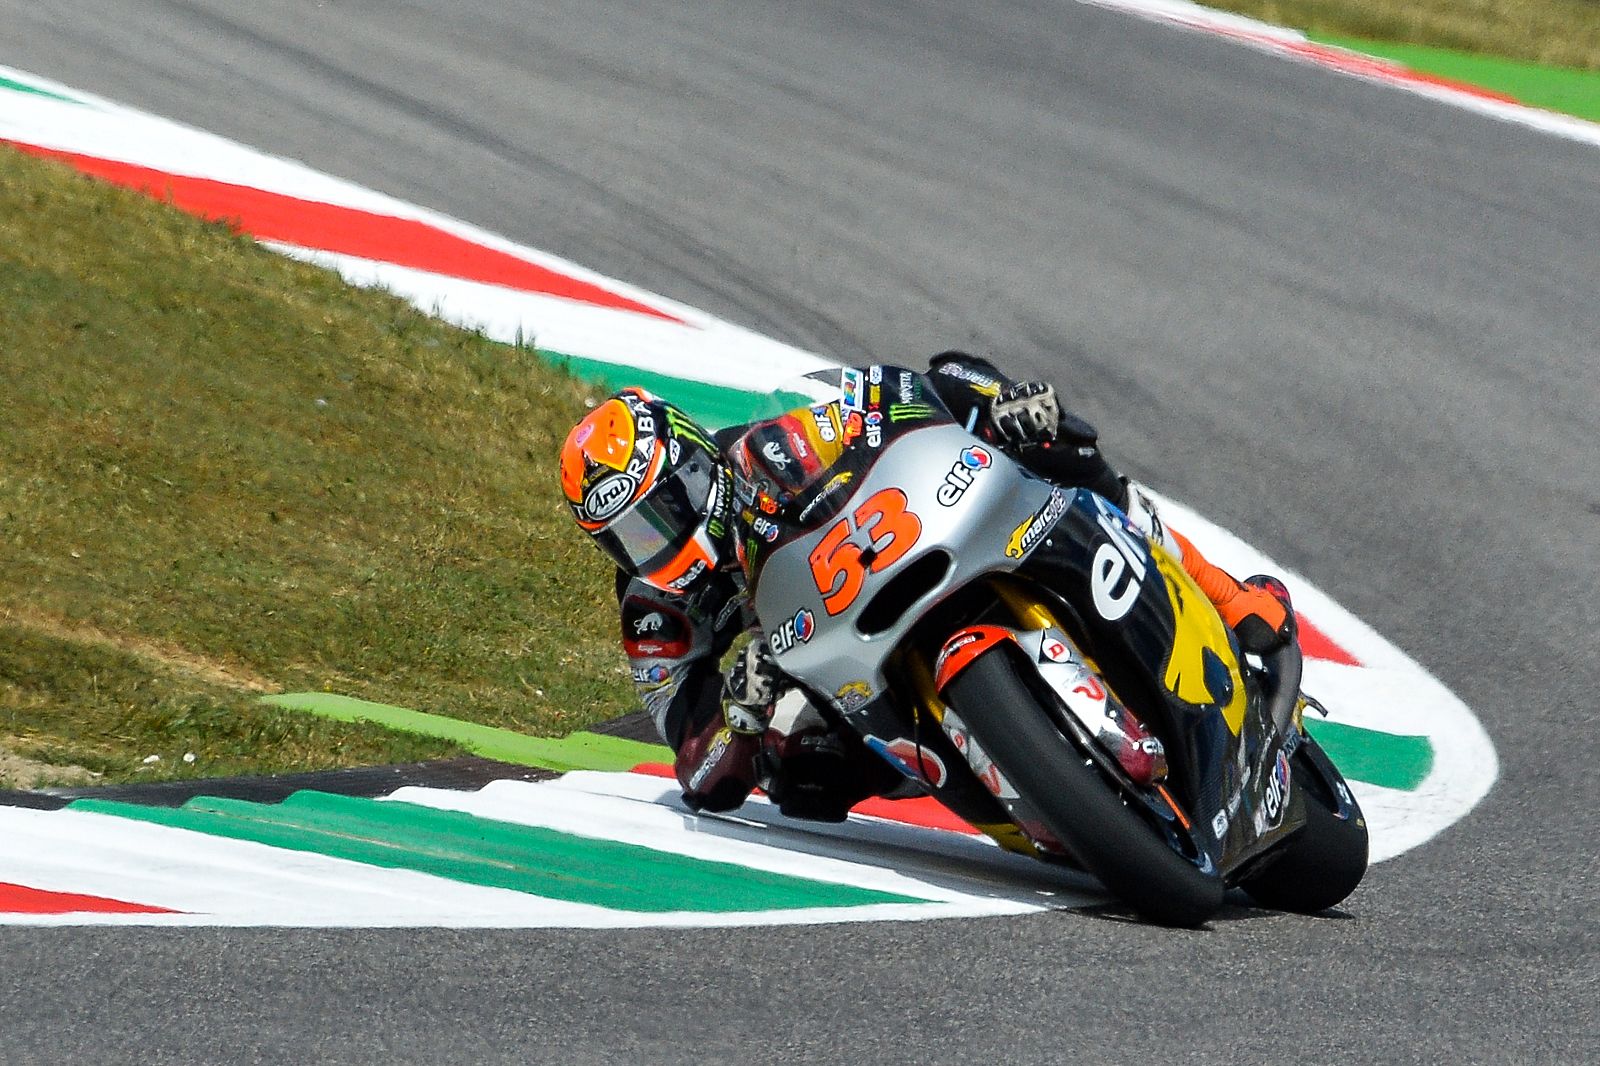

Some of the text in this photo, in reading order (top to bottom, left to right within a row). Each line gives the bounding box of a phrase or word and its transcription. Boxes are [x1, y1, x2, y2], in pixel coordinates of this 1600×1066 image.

[813, 413, 836, 443] elf
[590, 480, 627, 515] Arai
[937, 461, 975, 507] elf
[808, 487, 922, 617] 53
[770, 617, 795, 655] elf
[1264, 765, 1282, 818] elf
